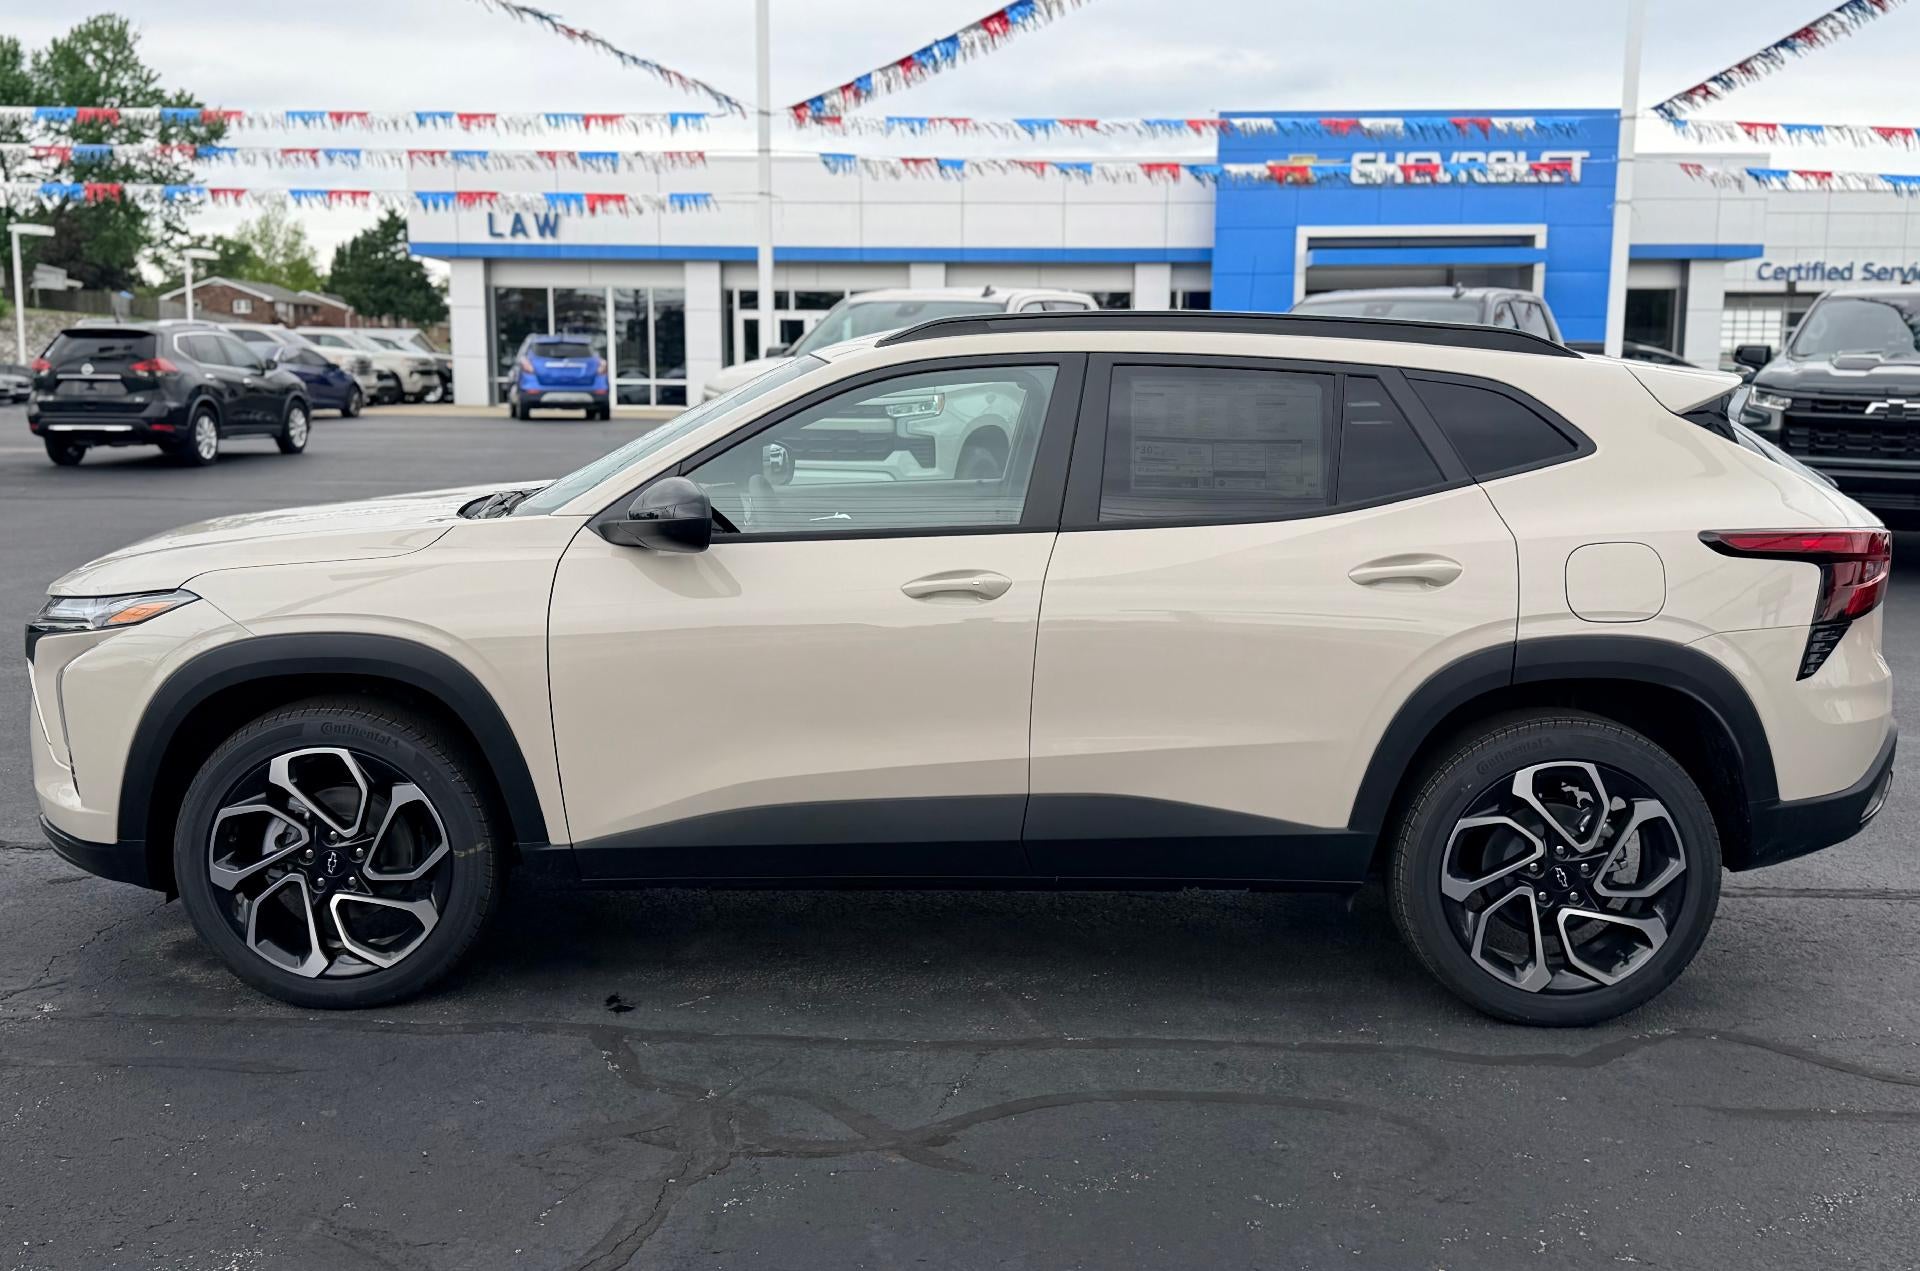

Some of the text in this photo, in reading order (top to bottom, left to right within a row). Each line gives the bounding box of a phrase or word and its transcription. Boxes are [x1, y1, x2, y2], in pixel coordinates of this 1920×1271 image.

[487, 211, 559, 239] LAW
[1757, 261, 1920, 281] Certified Servi
[320, 721, 392, 746] Continental
